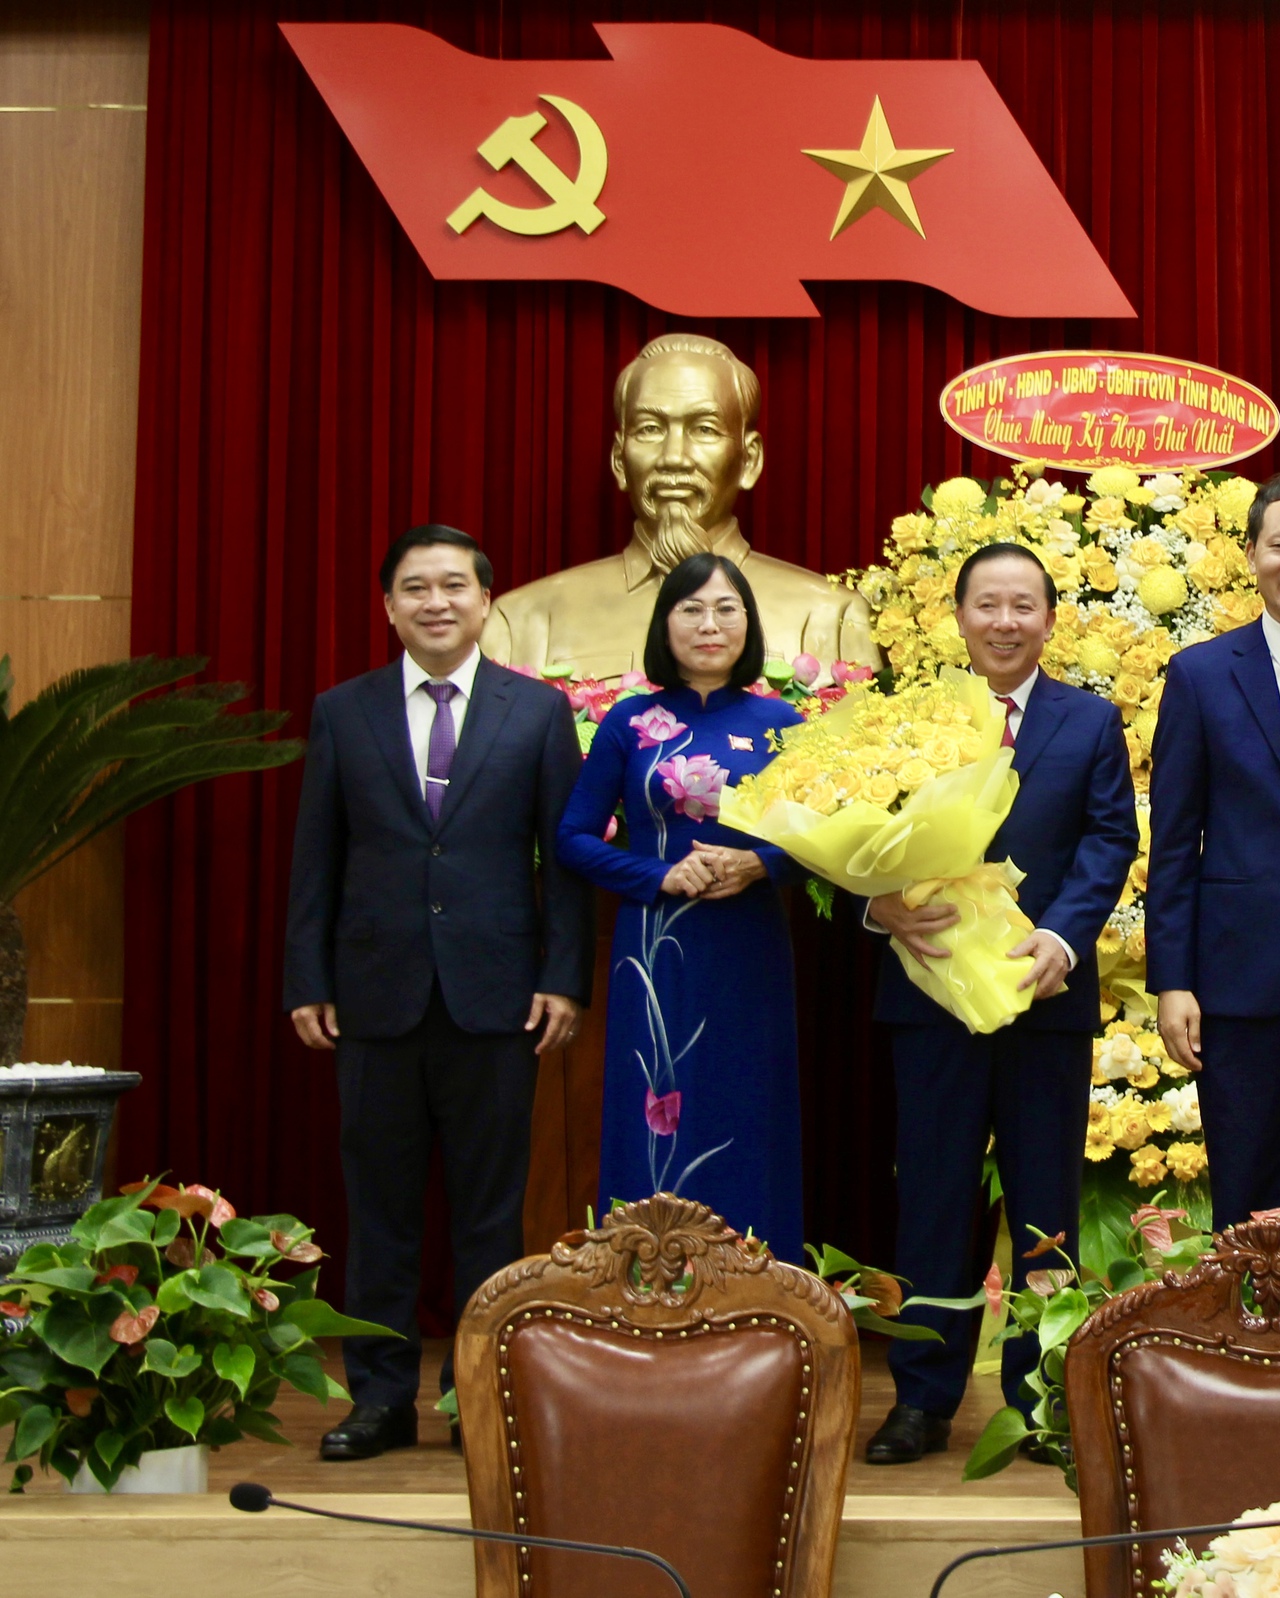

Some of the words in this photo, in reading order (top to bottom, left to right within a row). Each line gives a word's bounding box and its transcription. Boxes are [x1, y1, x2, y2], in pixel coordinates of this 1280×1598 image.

[954, 378, 986, 417] TỈNH
[988, 369, 1007, 407] ỦY
[1016, 368, 1053, 400] HĐND
[1061, 366, 1098, 395] UBND
[1106, 366, 1177, 403] UBMTTQVN
[1178, 368, 1209, 411] TỈNH
[1210, 378, 1246, 426] ĐỒNG
[1247, 400, 1271, 437] NAI
[983, 406, 1024, 444] Chúc
[1024, 408, 1074, 455] Mừng
[1076, 410, 1106, 456] Kỳ
[1109, 412, 1147, 459] Họp
[1152, 414, 1190, 453] Thứ
[1190, 416, 1237, 456] Nhất
